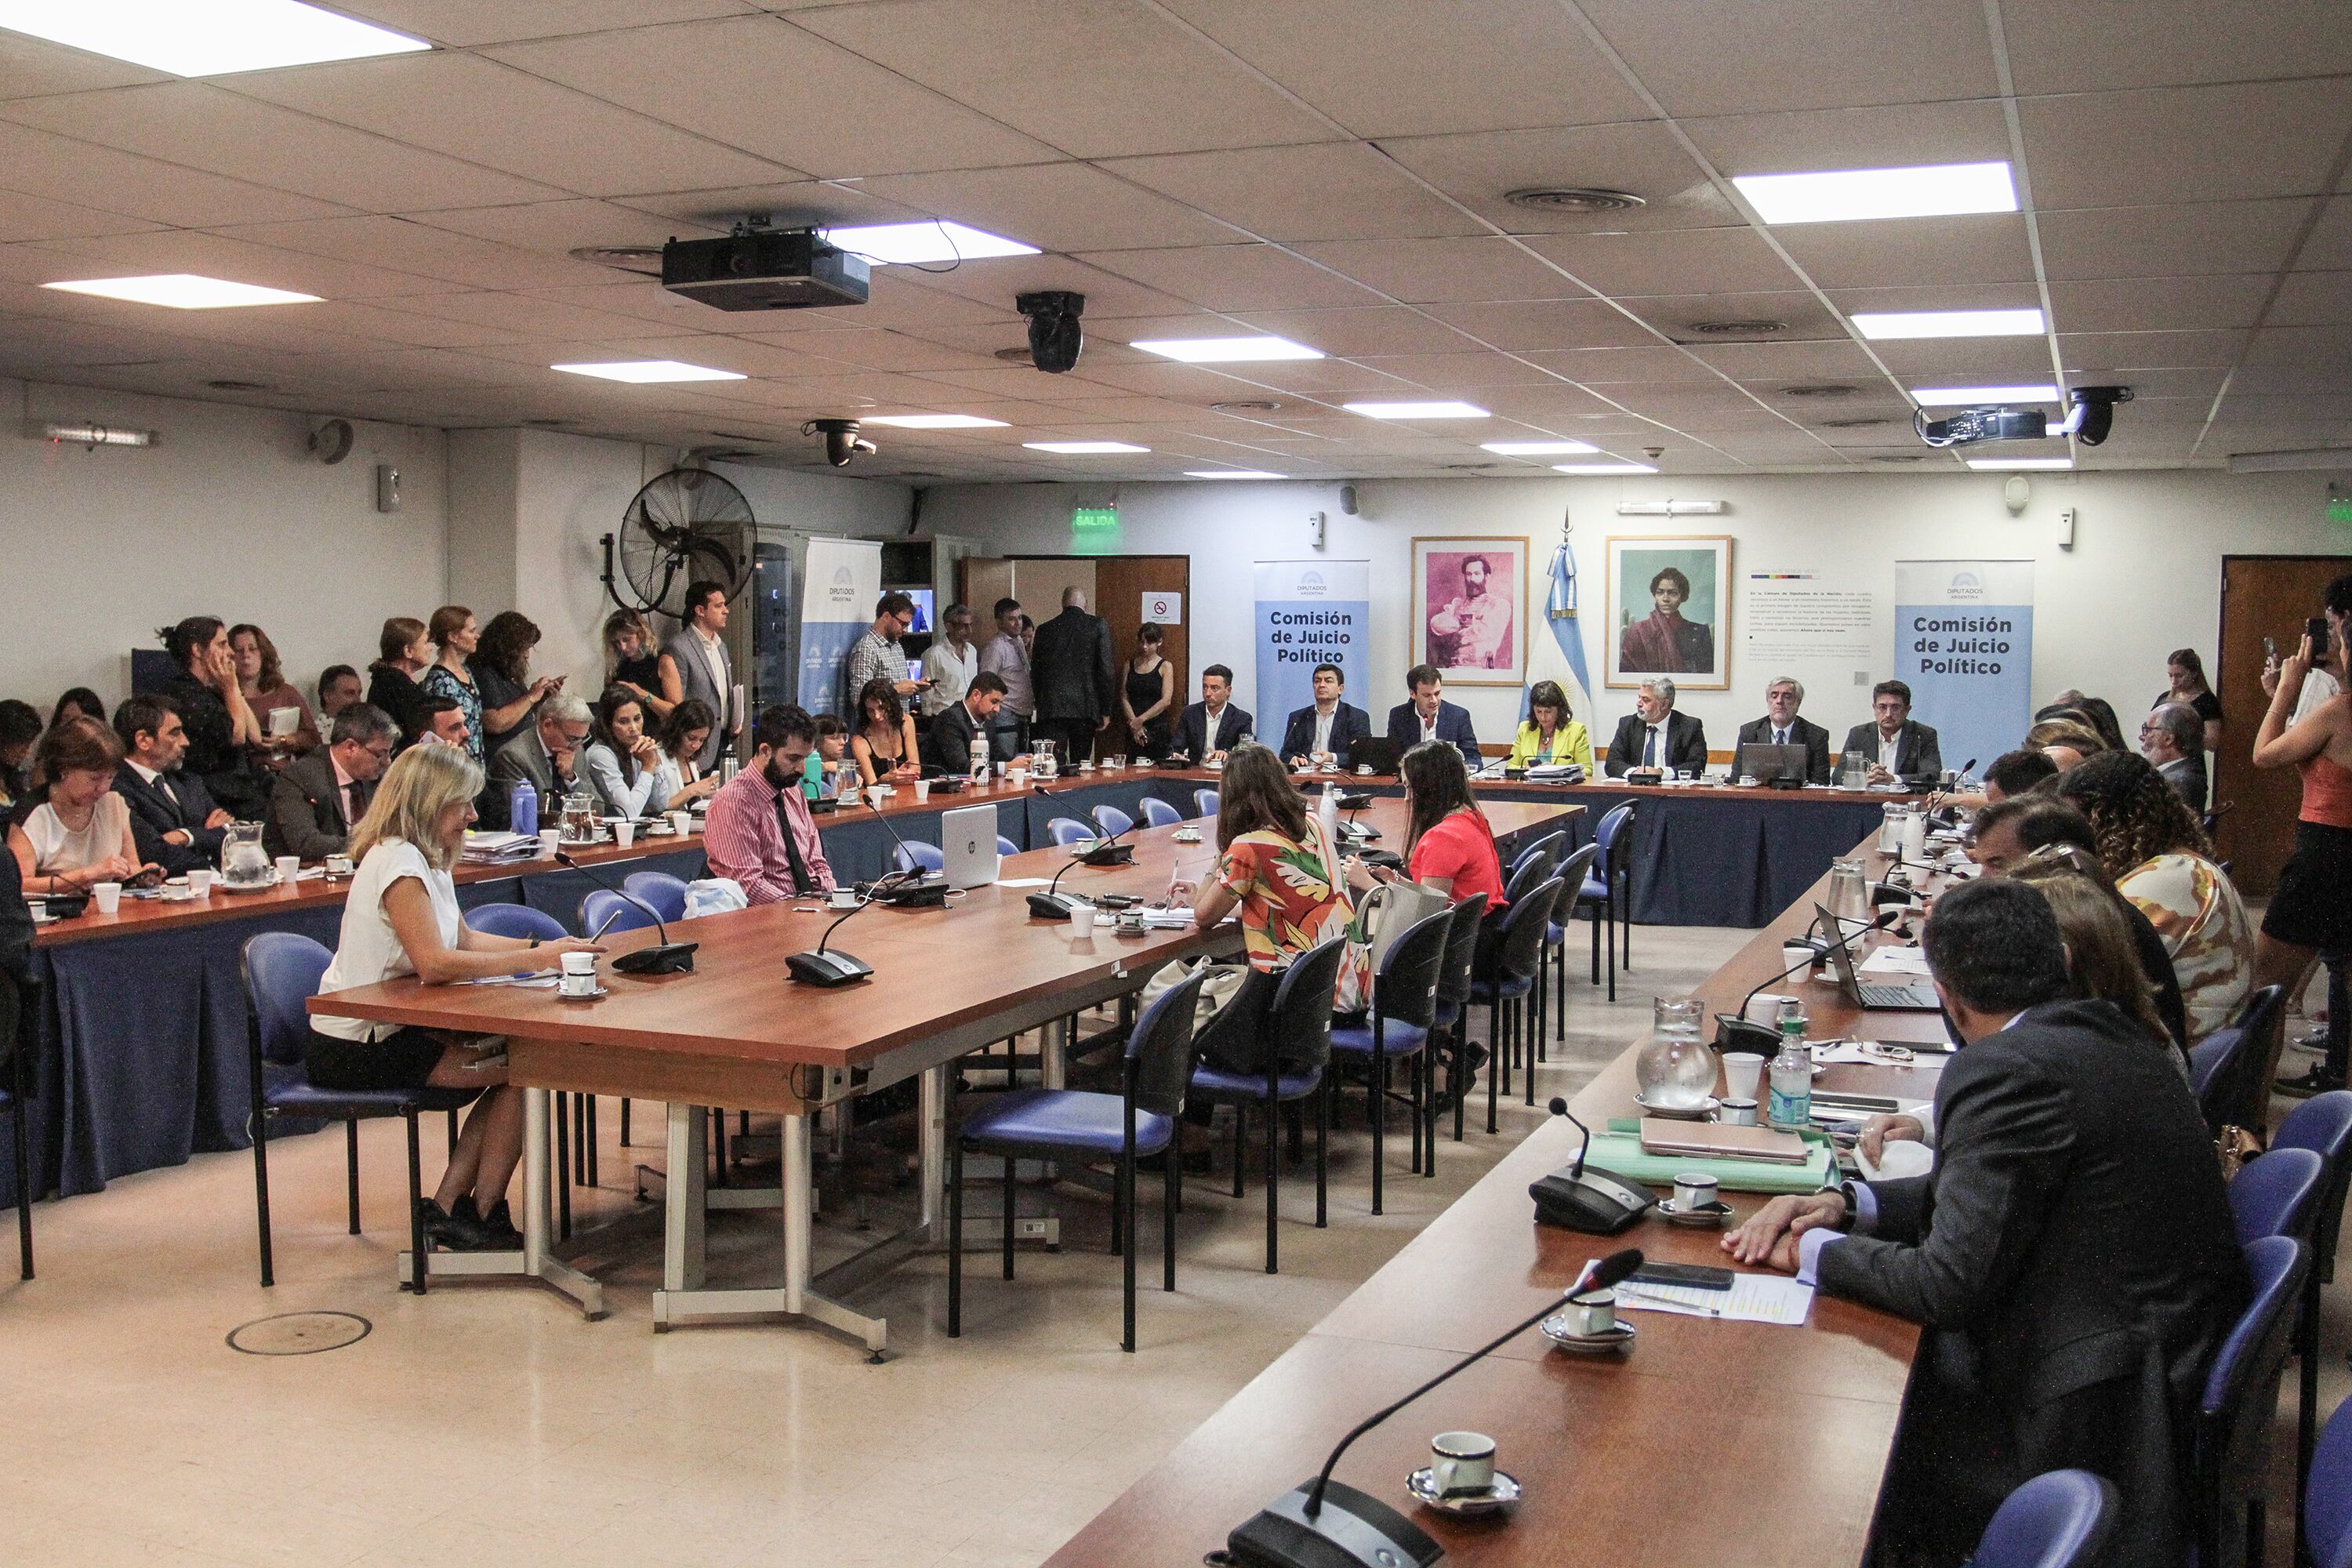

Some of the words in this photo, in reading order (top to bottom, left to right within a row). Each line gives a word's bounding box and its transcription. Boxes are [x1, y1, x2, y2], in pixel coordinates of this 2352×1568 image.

[1076, 516, 1115, 526] SALIDA
[1270, 611, 1352, 626] Comisión
[1913, 616, 2012, 633] Comisión
[1271, 630, 1293, 644] de
[1298, 630, 1351, 644] Juicio
[1914, 637, 1940, 653] de
[1946, 637, 2010, 654] Juicio
[1277, 648, 1344, 663] Político
[1920, 658, 2002, 675] Político
